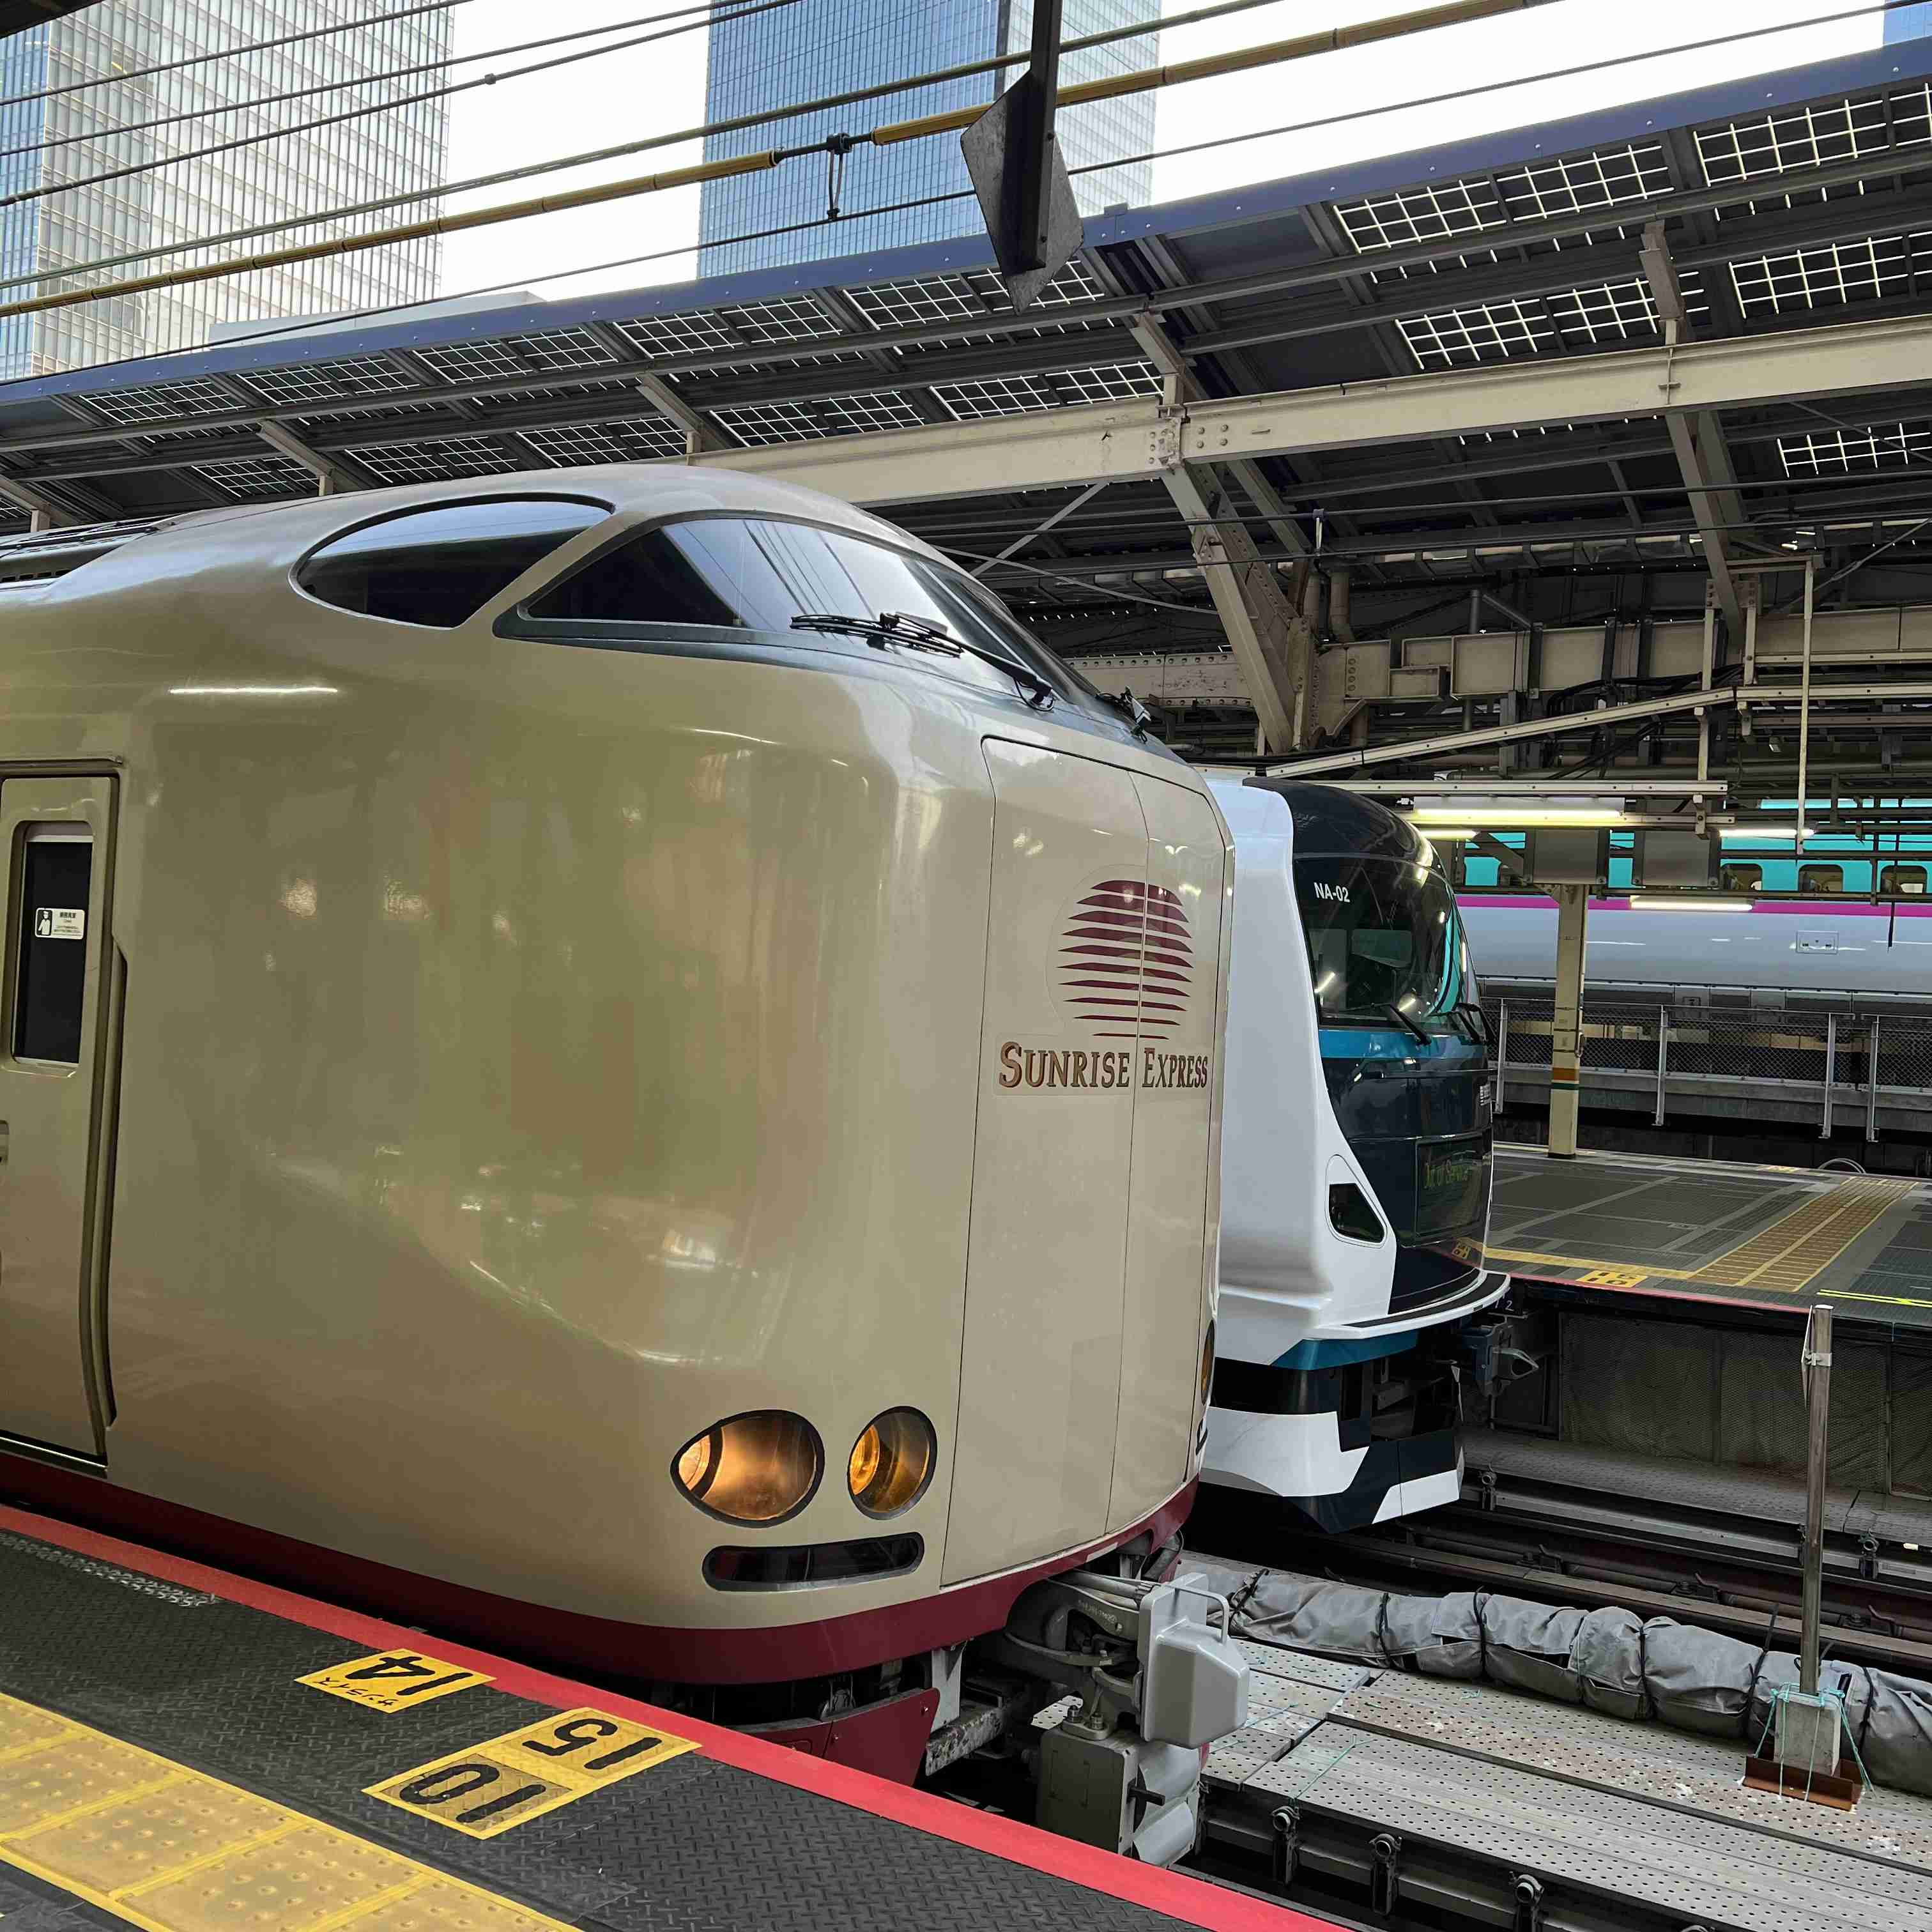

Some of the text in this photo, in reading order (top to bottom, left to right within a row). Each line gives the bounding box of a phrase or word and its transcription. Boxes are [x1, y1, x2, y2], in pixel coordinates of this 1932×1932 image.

[1314, 882, 1350, 902] NA-02
[999, 1041, 1208, 1088] SUNRISE EXPRESS
[345, 1656, 474, 1696] 14
[521, 1718, 663, 1770] 15
[399, 1763, 547, 1823] 10
